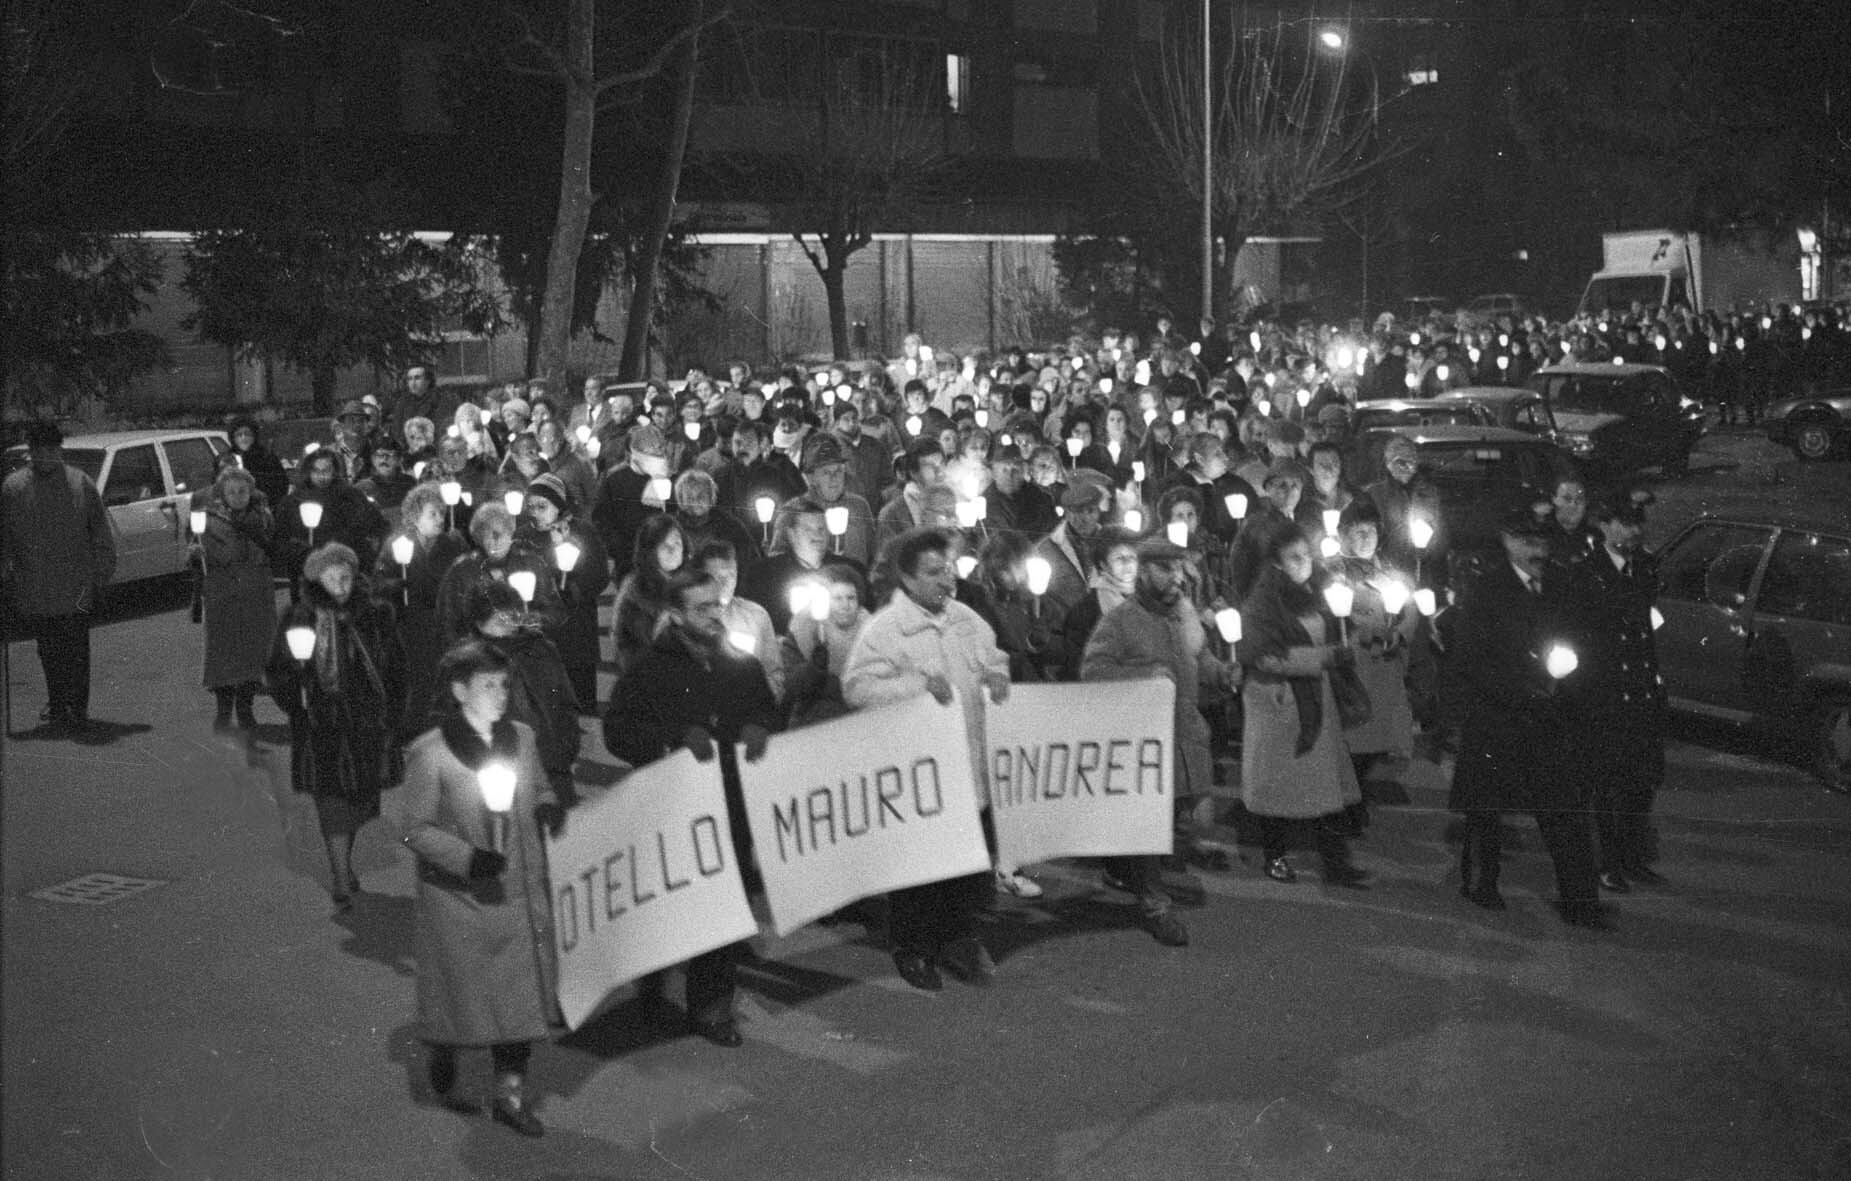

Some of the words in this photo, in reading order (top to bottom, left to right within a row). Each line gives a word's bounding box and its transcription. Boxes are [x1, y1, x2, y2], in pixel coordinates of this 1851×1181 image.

[773, 757, 943, 864] MAURO
[995, 738, 1163, 810] ANDREA
[558, 814, 725, 953] OTELLO
